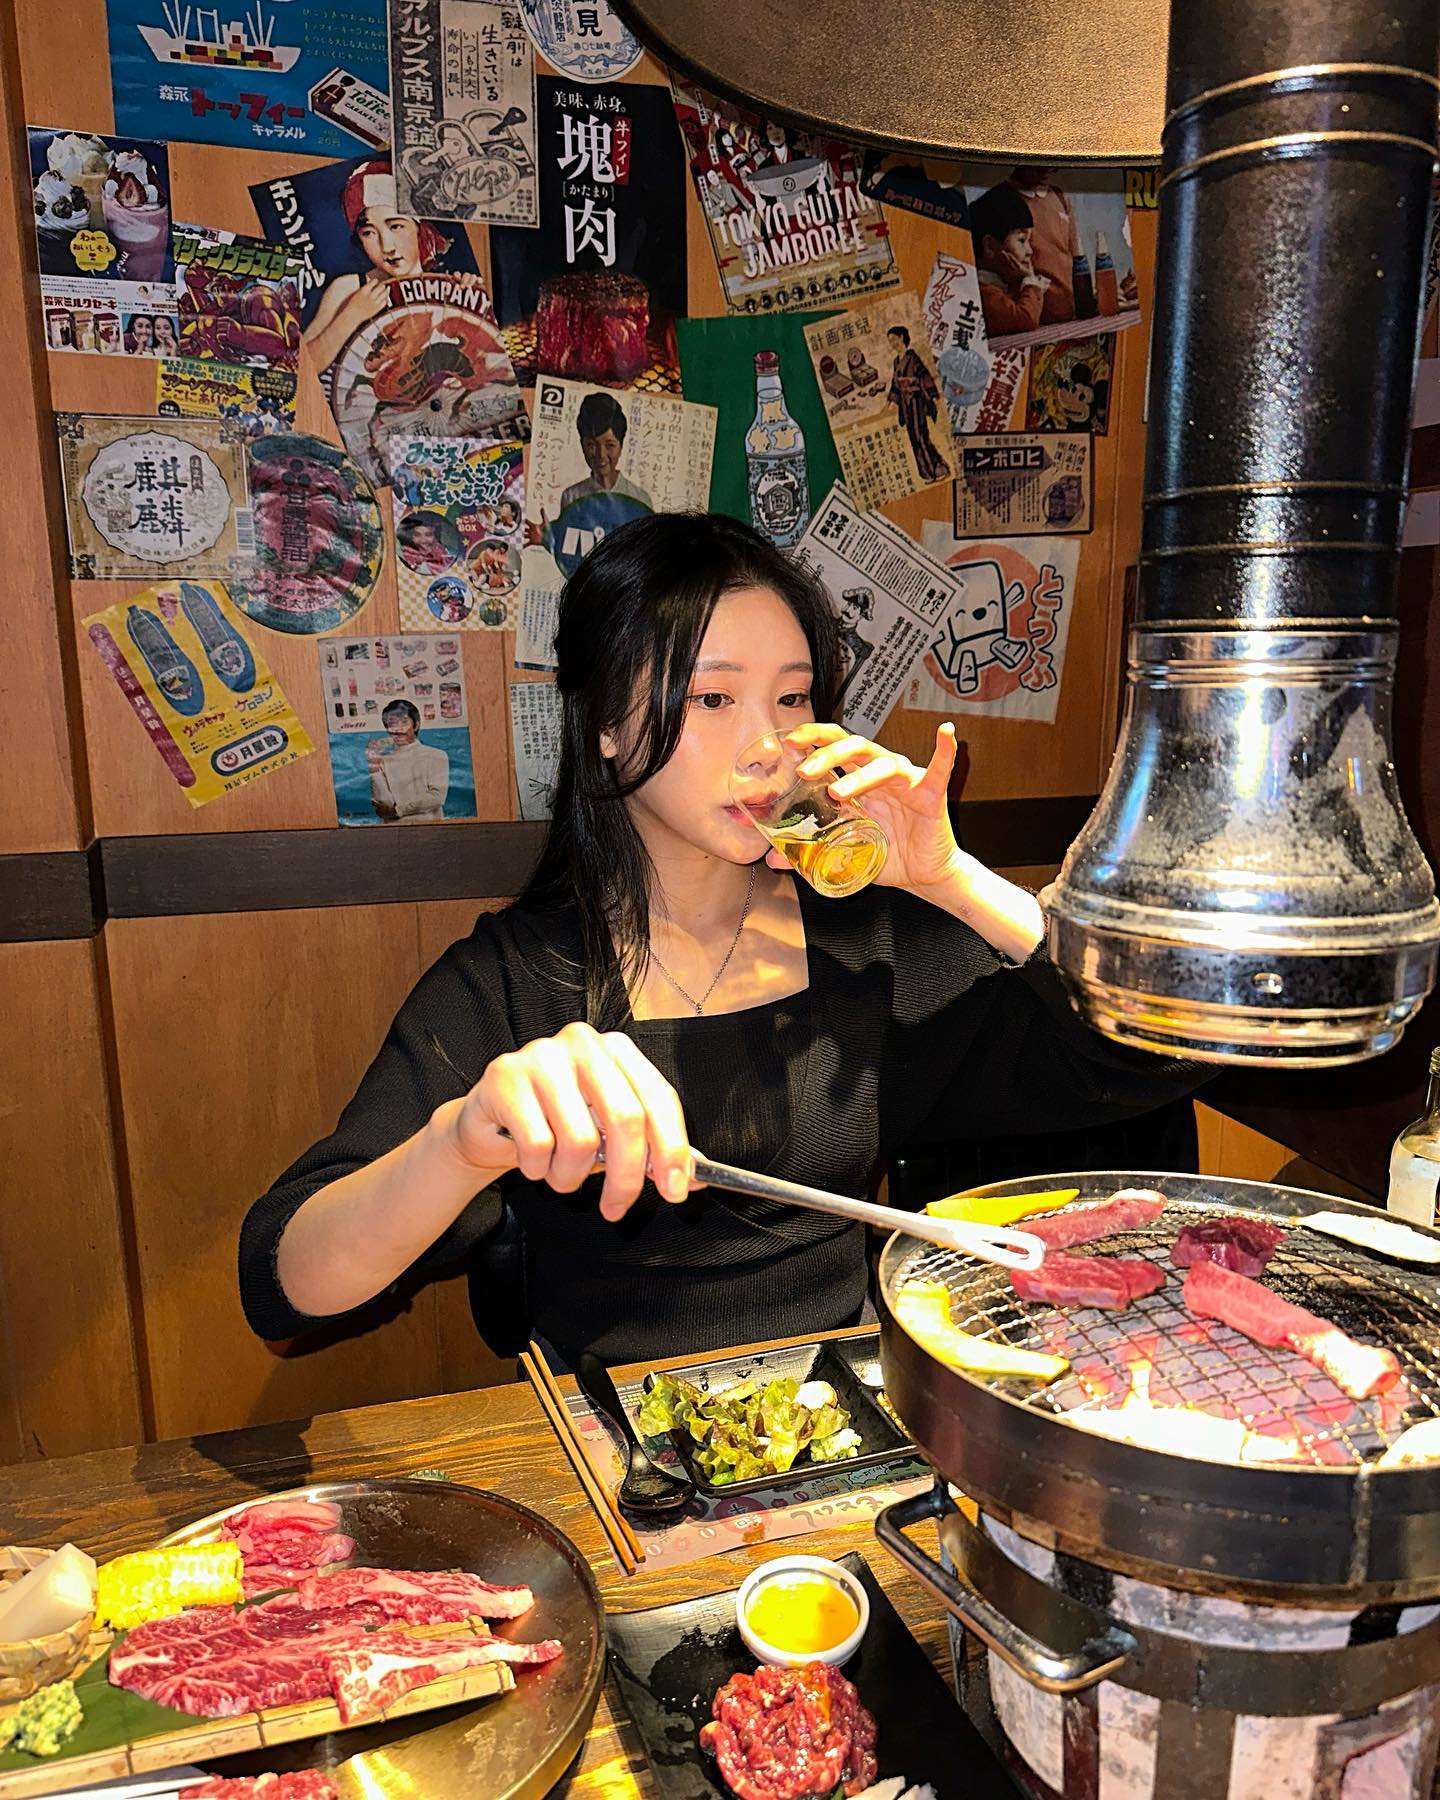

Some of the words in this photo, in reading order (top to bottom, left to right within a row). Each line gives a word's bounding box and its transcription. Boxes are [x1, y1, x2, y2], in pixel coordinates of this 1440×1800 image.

[482, 24, 502, 101] 生きている
[159, 85, 189, 103] 森永
[348, 88, 391, 120] Toffee
[553, 91, 627, 113] 美味、赤身。
[252, 123, 306, 139] キャラメル
[556, 113, 616, 184] 塊
[614, 120, 630, 178] 牛フィレ
[564, 198, 617, 267] 肉
[713, 202, 790, 249] TOKYO
[796, 185, 874, 234] GUITAR
[743, 218, 868, 278] JAMBOREE
[401, 279, 492, 313] COMPANY
[458, 524, 478, 532] BOX
[1021, 566, 1063, 690] とうふ
[234, 686, 273, 712] ケロヨン
